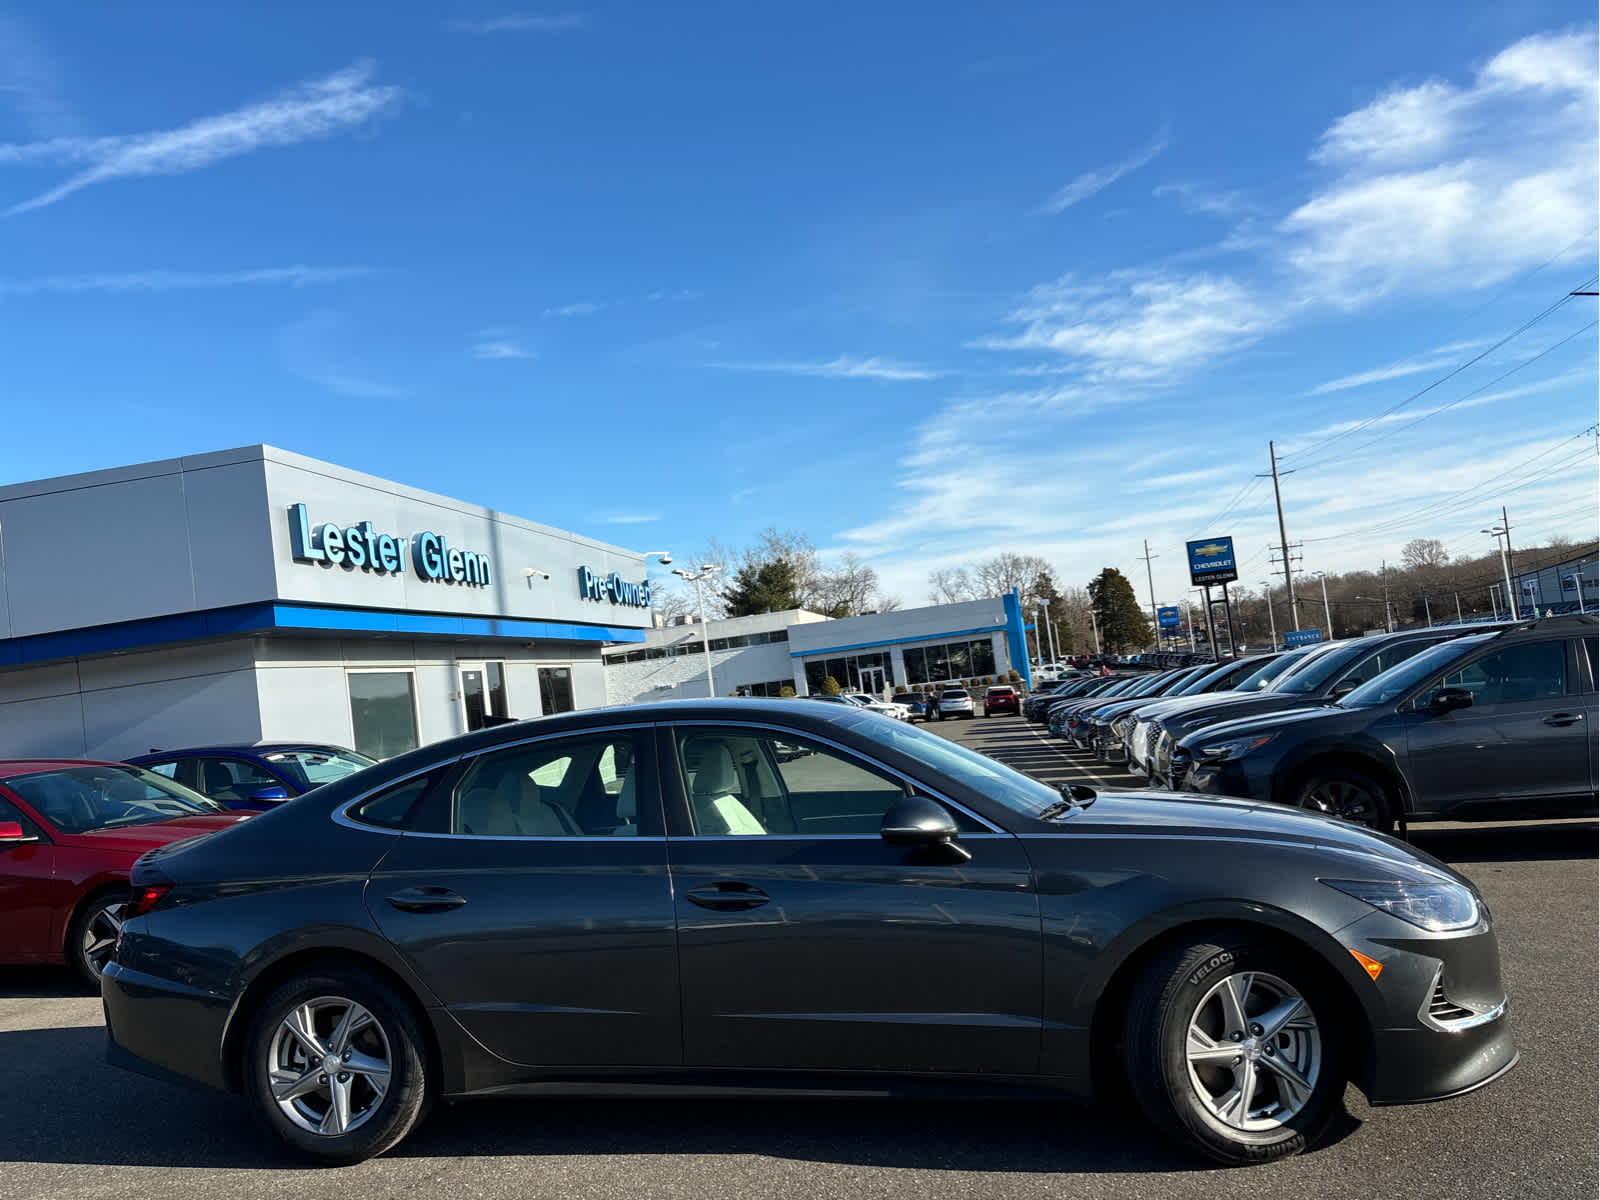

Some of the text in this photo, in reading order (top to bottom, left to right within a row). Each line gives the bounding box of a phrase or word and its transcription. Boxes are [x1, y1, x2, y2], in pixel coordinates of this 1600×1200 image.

[288, 503, 493, 586] Lester Glenn
[578, 565, 652, 607] Pre-Owned
